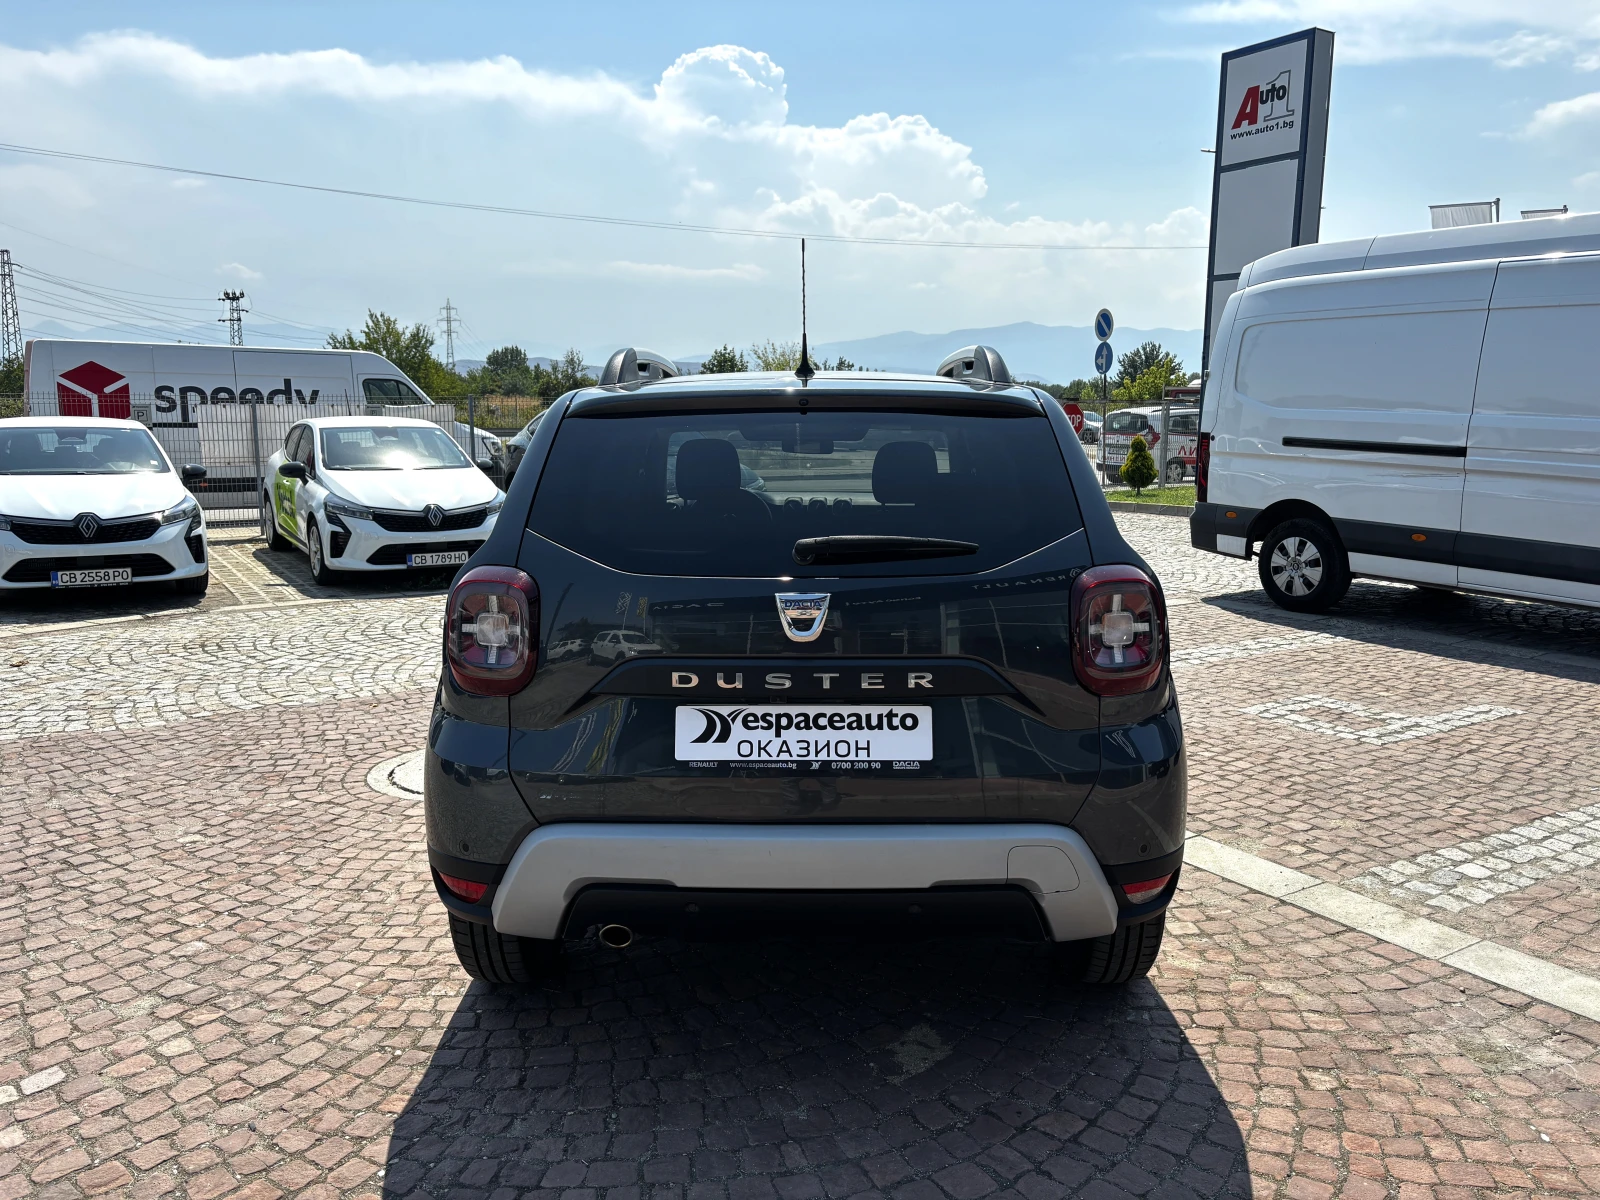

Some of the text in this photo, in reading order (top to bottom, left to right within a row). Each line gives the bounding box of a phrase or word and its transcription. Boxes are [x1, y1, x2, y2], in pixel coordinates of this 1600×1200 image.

[1231, 83, 1287, 130] Auto
[1230, 120, 1294, 140] www.auto1.bg
[1067, 414, 1082, 427] OP
[414, 555, 427, 565] CB
[430, 554, 452, 564] 1789
[60, 572, 77, 584] CB
[80, 571, 110, 582] 2558
[784, 600, 822, 608] DACIA
[671, 671, 934, 689] DUSTER
[741, 707, 919, 738] espaceauto
[737, 739, 871, 758] ОКАЗИОН
[729, 761, 797, 770] www.espaceauto.bg
[831, 761, 851, 769] 0700
[853, 761, 869, 769] 200
[870, 761, 881, 769] 90
